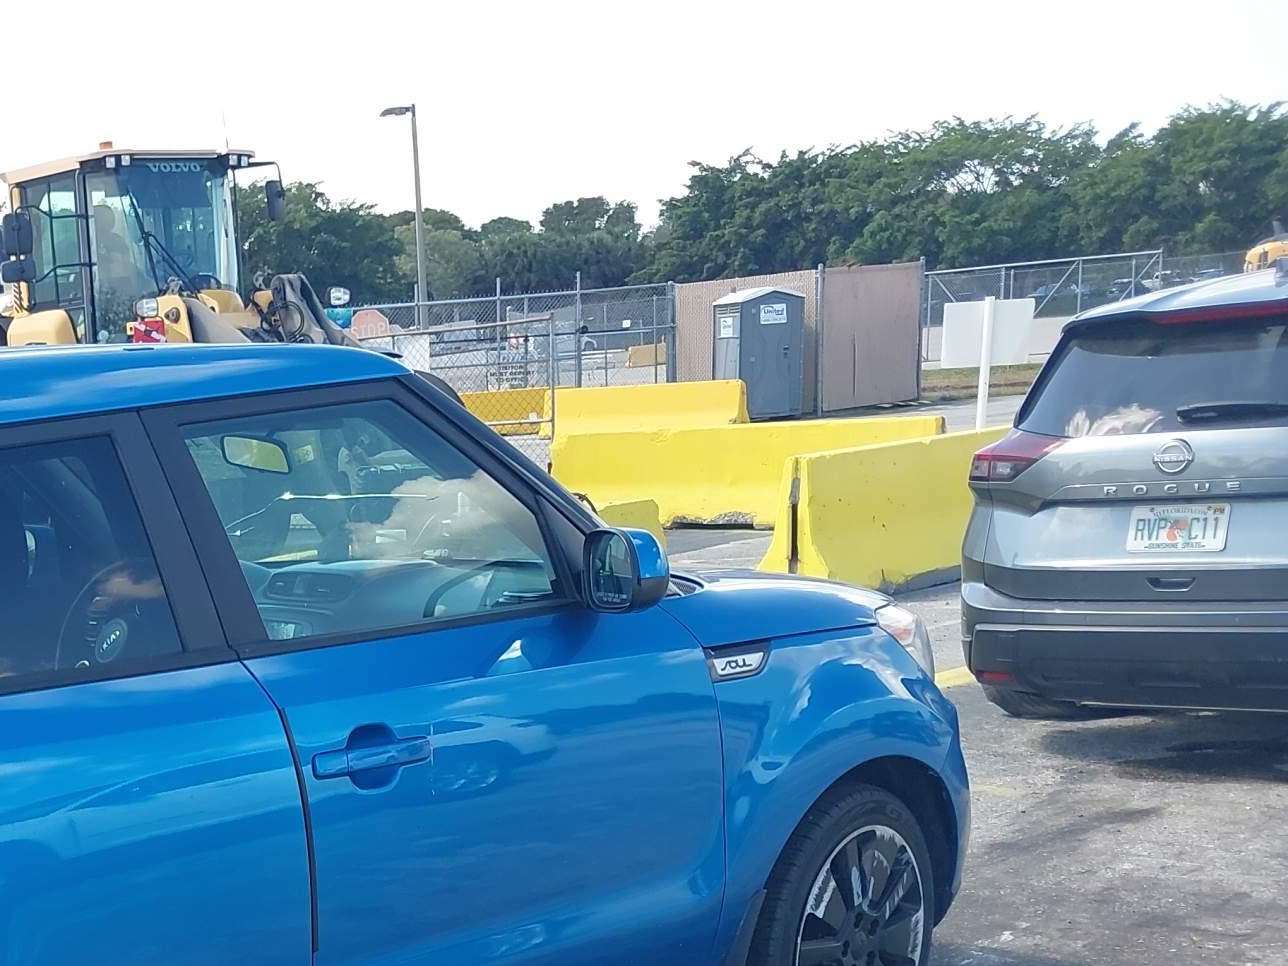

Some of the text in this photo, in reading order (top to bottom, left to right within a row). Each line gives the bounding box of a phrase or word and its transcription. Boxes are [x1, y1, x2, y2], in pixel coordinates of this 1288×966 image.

[145, 162, 201, 173] VOLVO
[1153, 454, 1193, 463] NISSAN
[1103, 481, 1241, 496] ROGUE
[1134, 516, 1219, 541] RVP C11
